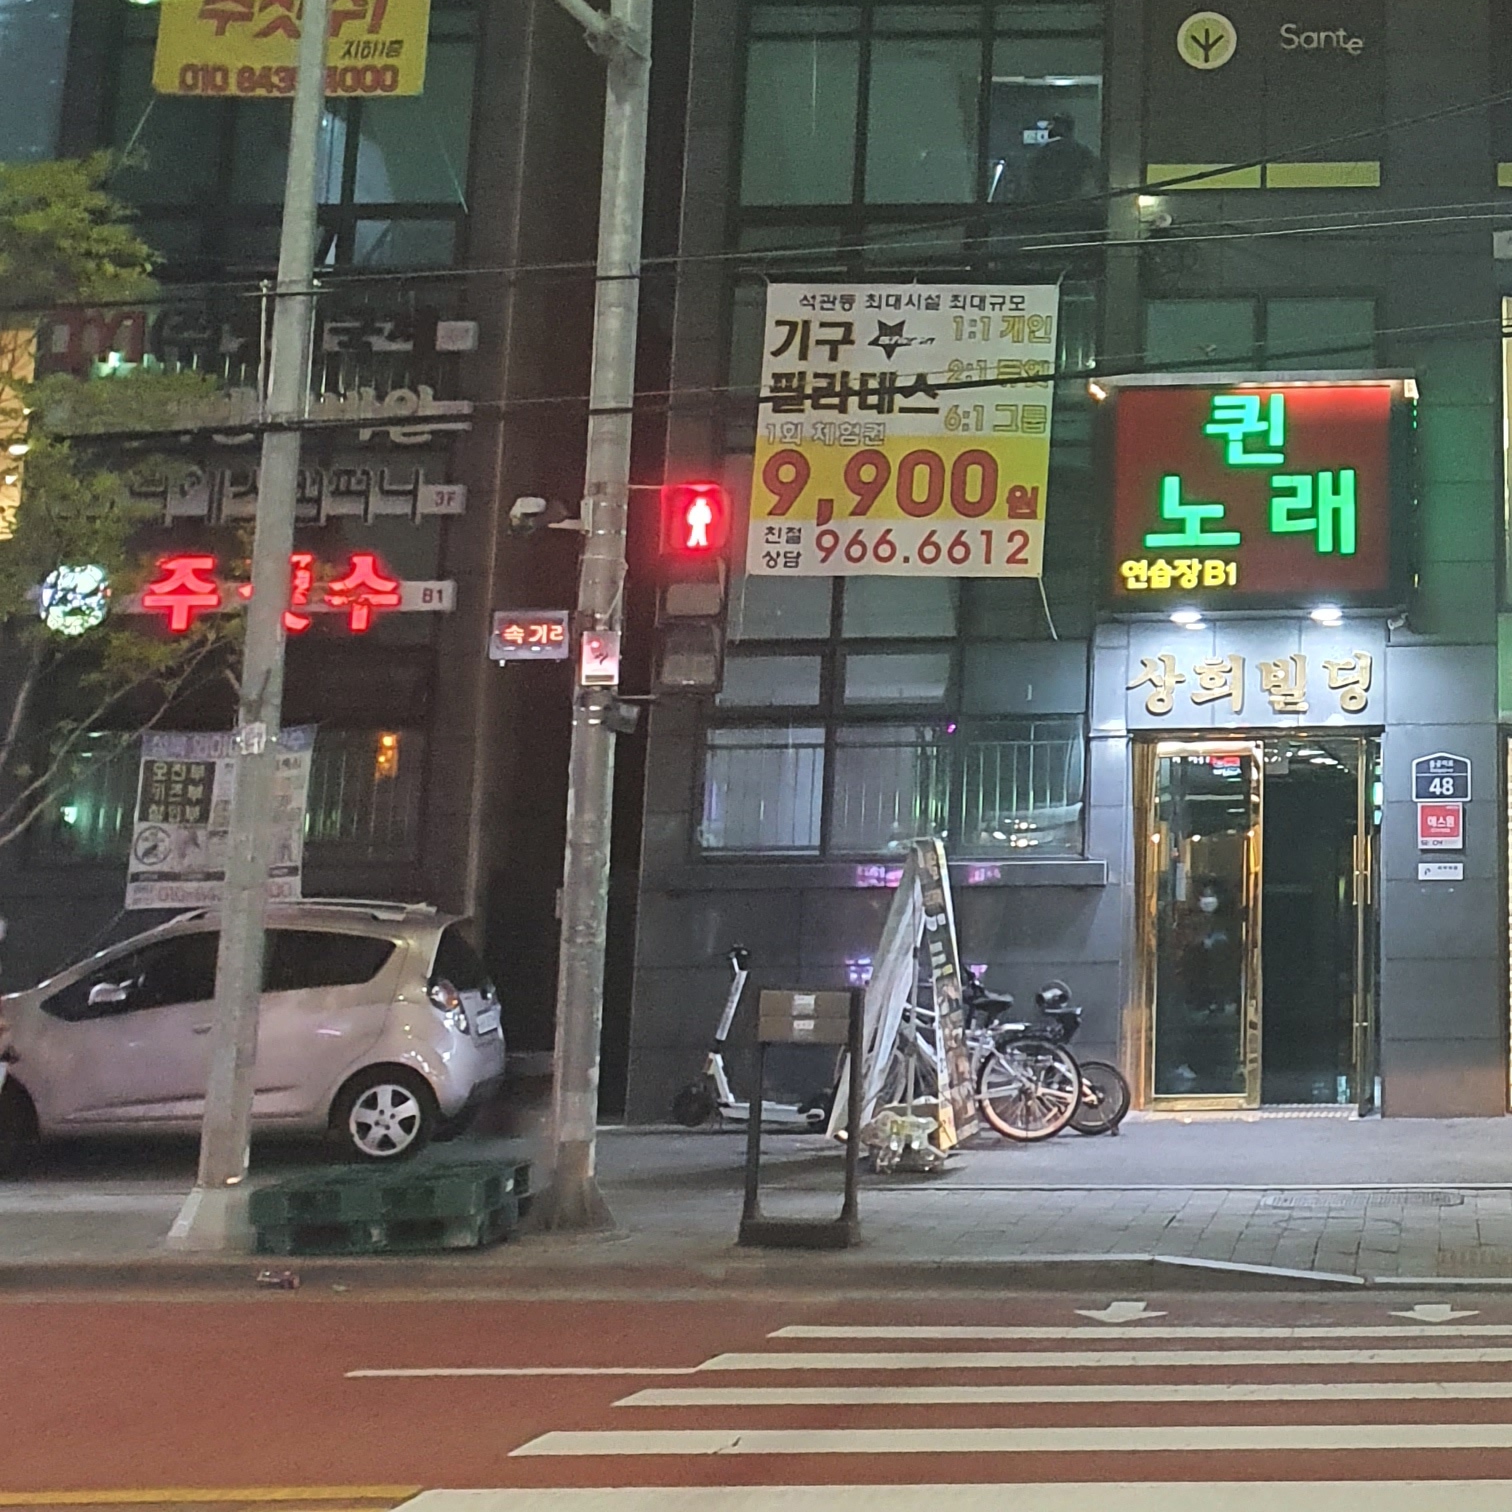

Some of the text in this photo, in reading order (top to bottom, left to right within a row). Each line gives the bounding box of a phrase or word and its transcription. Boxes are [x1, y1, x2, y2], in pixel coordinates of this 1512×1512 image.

[1279, 22, 1365, 56] Sante
[177, 62, 229, 93] 010
[798, 292, 1027, 312] 석관동 최대시설 최대규모
[769, 319, 857, 363] 기구
[952, 314, 1053, 345] 1:1 개인
[765, 421, 887, 447] 1회 체험권
[943, 403, 1048, 434] 6:1 그룹
[1203, 393, 1285, 466] 퀸
[435, 490, 456, 507] 3F
[1144, 468, 1357, 555] 노래
[763, 525, 803, 545] 친절
[814, 528, 1031, 566] 966.6612
[761, 549, 803, 569] 상담
[421, 587, 445, 605] B1
[502, 623, 526, 644] 속
[1126, 649, 1374, 717] 상희빌딩
[1428, 777, 1454, 796] 48
